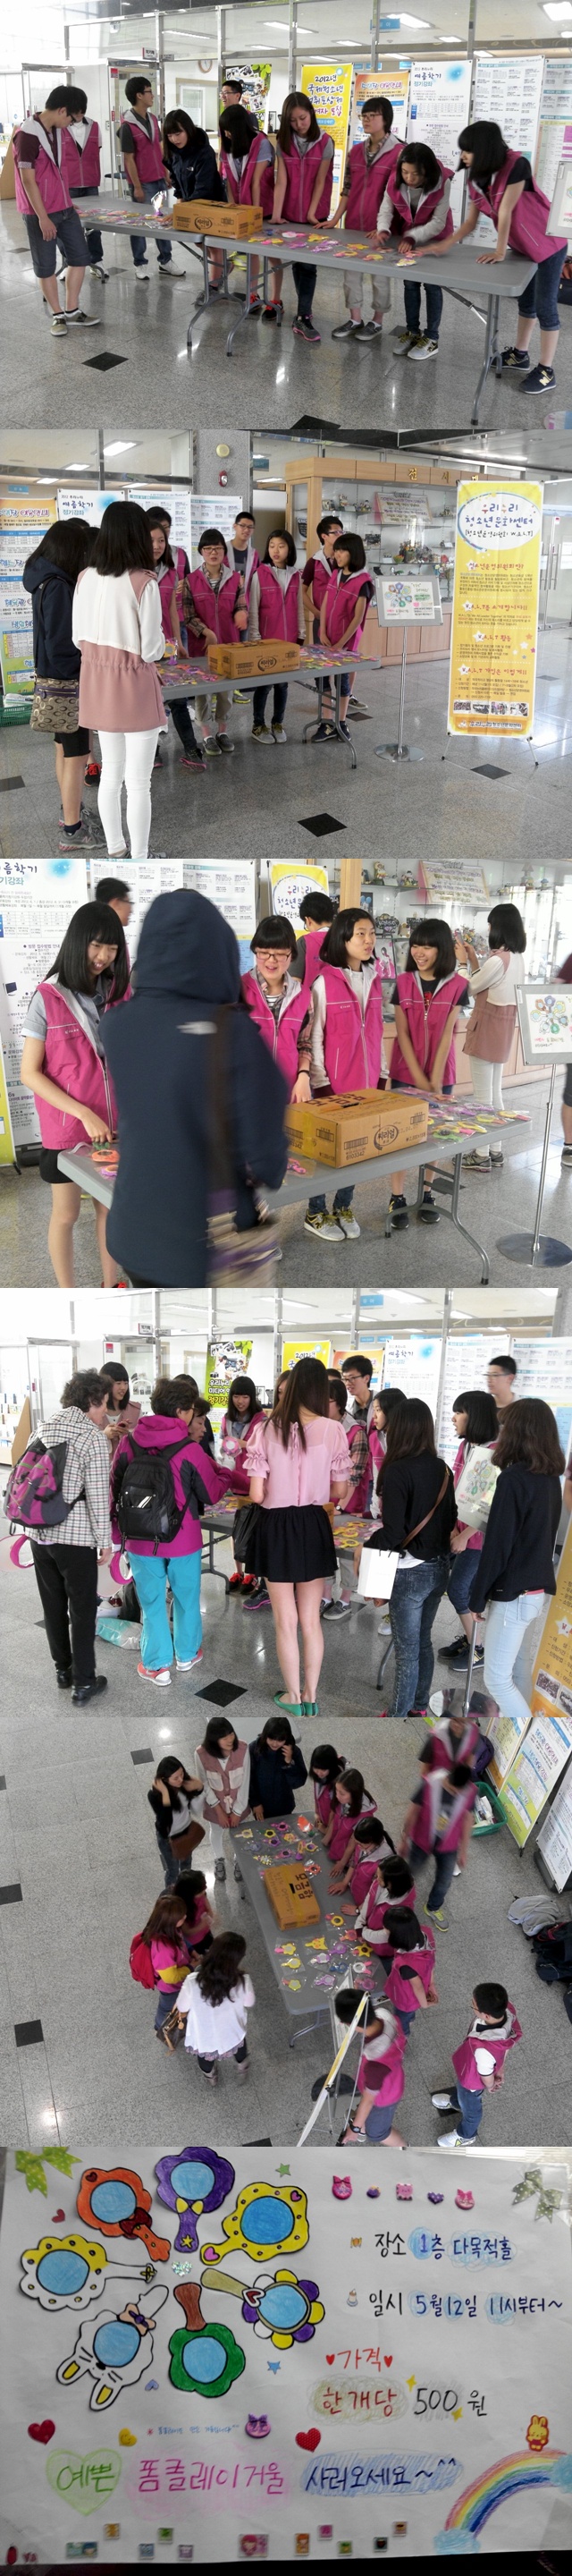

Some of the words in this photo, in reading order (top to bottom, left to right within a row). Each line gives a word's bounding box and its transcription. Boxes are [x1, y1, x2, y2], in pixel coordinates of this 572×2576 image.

[315, 74, 337, 82] 2012년
[414, 72, 442, 80] 여름학기
[307, 84, 344, 94] 국제청소년
[331, 106, 341, 116] 모집
[482, 504, 518, 513] 우리누리
[466, 515, 533, 528] 청소년문화센터
[0, 861, 38, 875] 름학기
[278, 896, 302, 909] 청소년문
[208, 1396, 229, 1406] 정기강
[375, 2231, 406, 2258] 장소
[419, 2233, 445, 2259] 1층
[453, 2236, 512, 2260] 다목적홀
[369, 2290, 402, 2318] 일시
[337, 2347, 382, 2372] 가격
[414, 2387, 458, 2416] 500
[467, 2389, 488, 2417] 원
[56, 2462, 115, 2494] 예쁜
